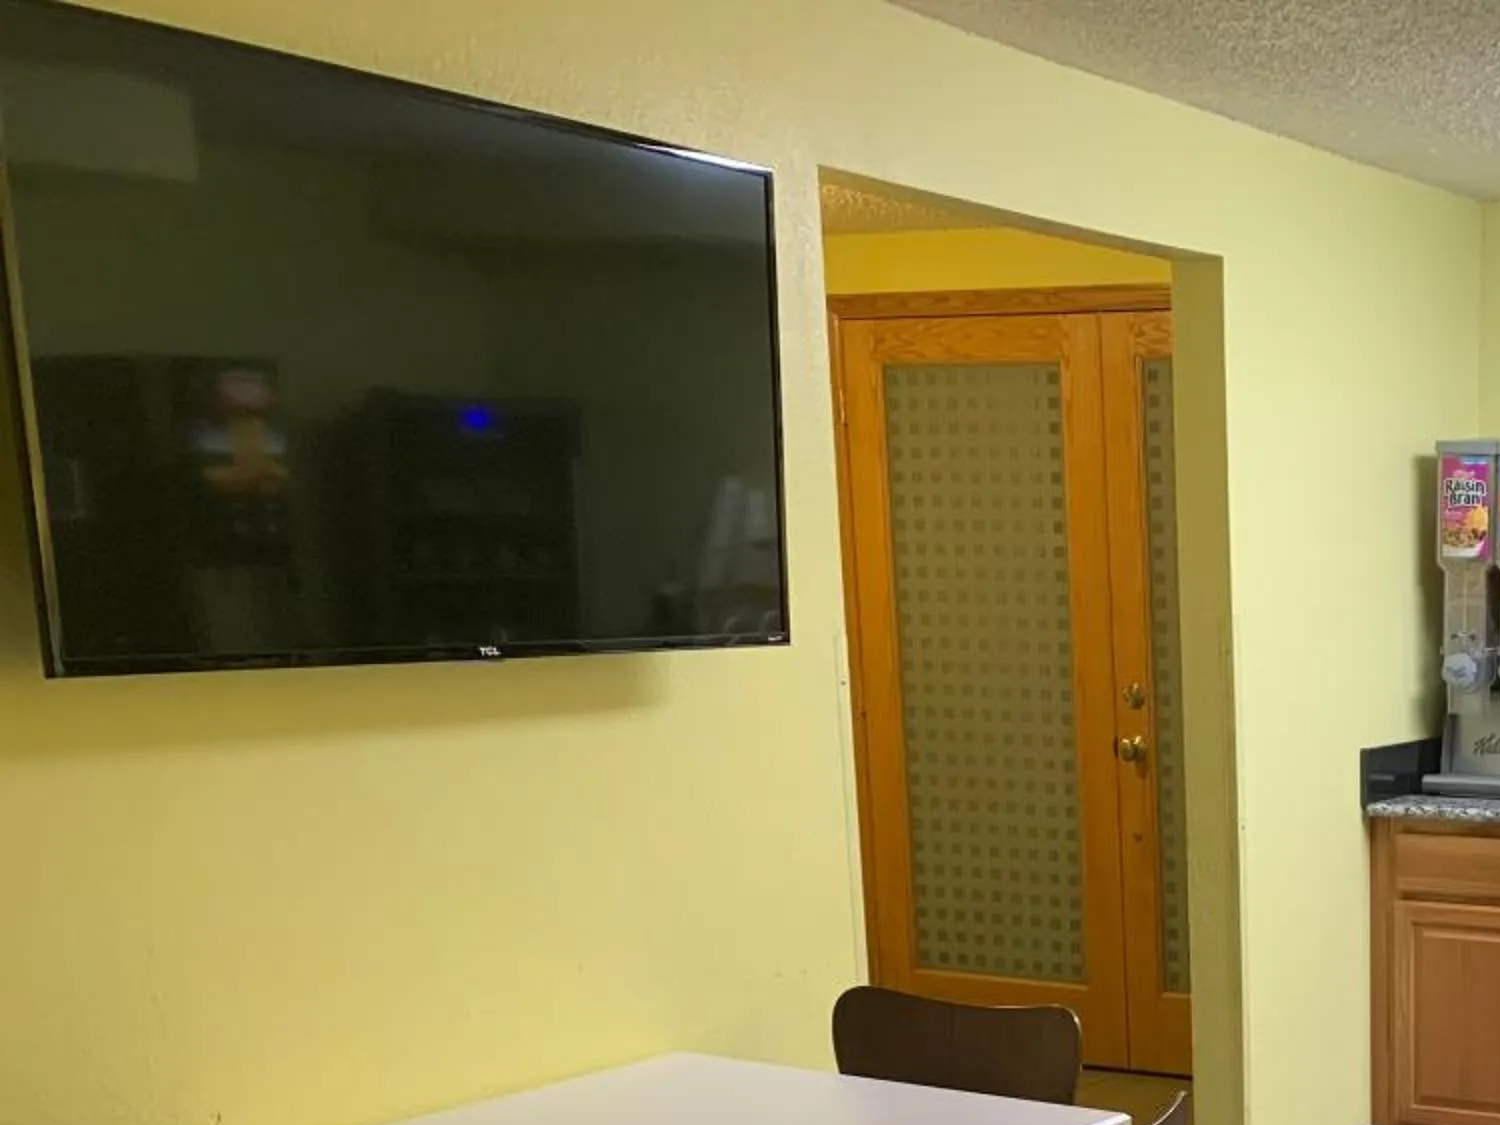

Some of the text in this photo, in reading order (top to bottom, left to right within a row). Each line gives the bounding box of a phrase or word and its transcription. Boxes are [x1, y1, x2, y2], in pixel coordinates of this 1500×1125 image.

[1445, 479, 1487, 495] Raisin
[1449, 492, 1481, 507] Bran
[480, 646, 502, 657] TCL
